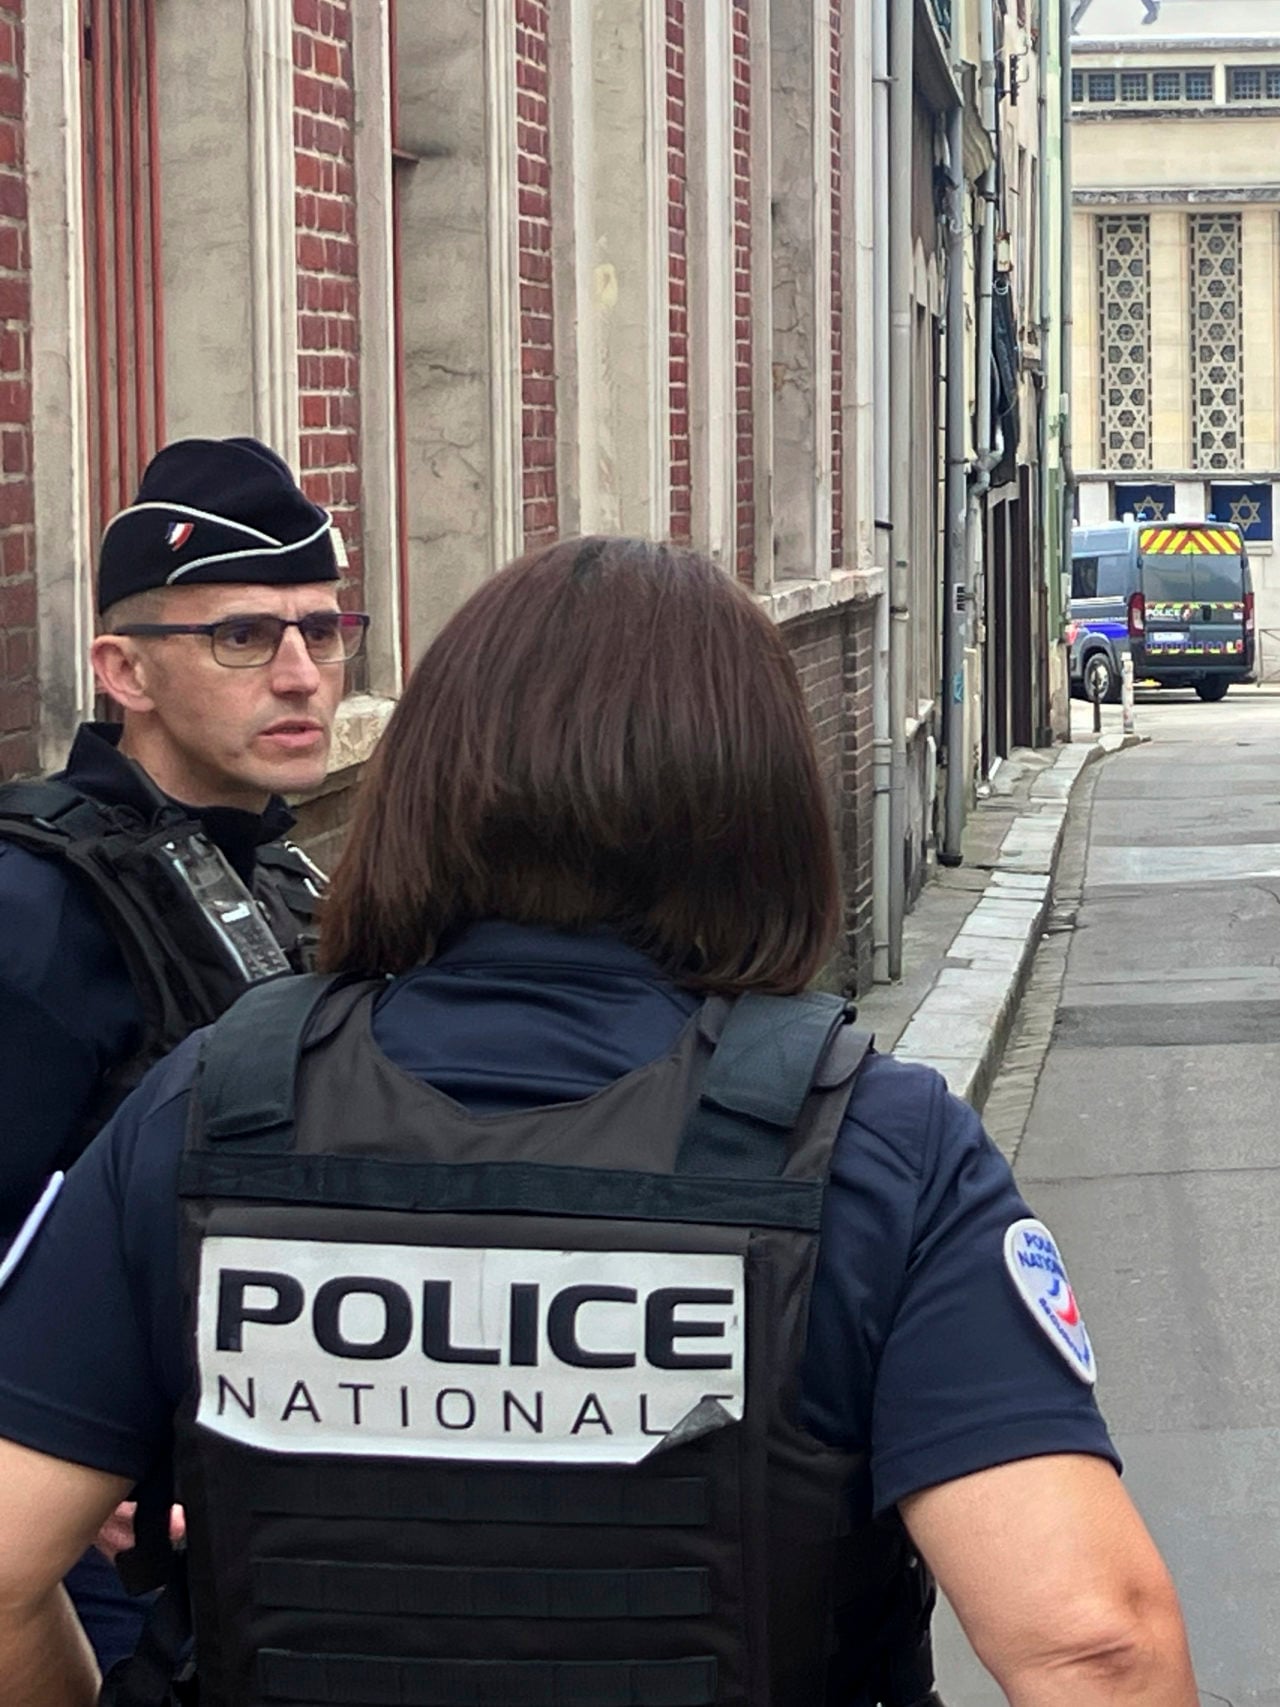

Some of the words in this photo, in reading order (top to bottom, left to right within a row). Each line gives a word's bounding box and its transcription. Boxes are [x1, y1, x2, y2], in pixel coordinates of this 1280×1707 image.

[1145, 608, 1182, 617] POLICE
[216, 1269, 734, 1370] POLICE
[217, 1375, 734, 1436] NATIONAL
